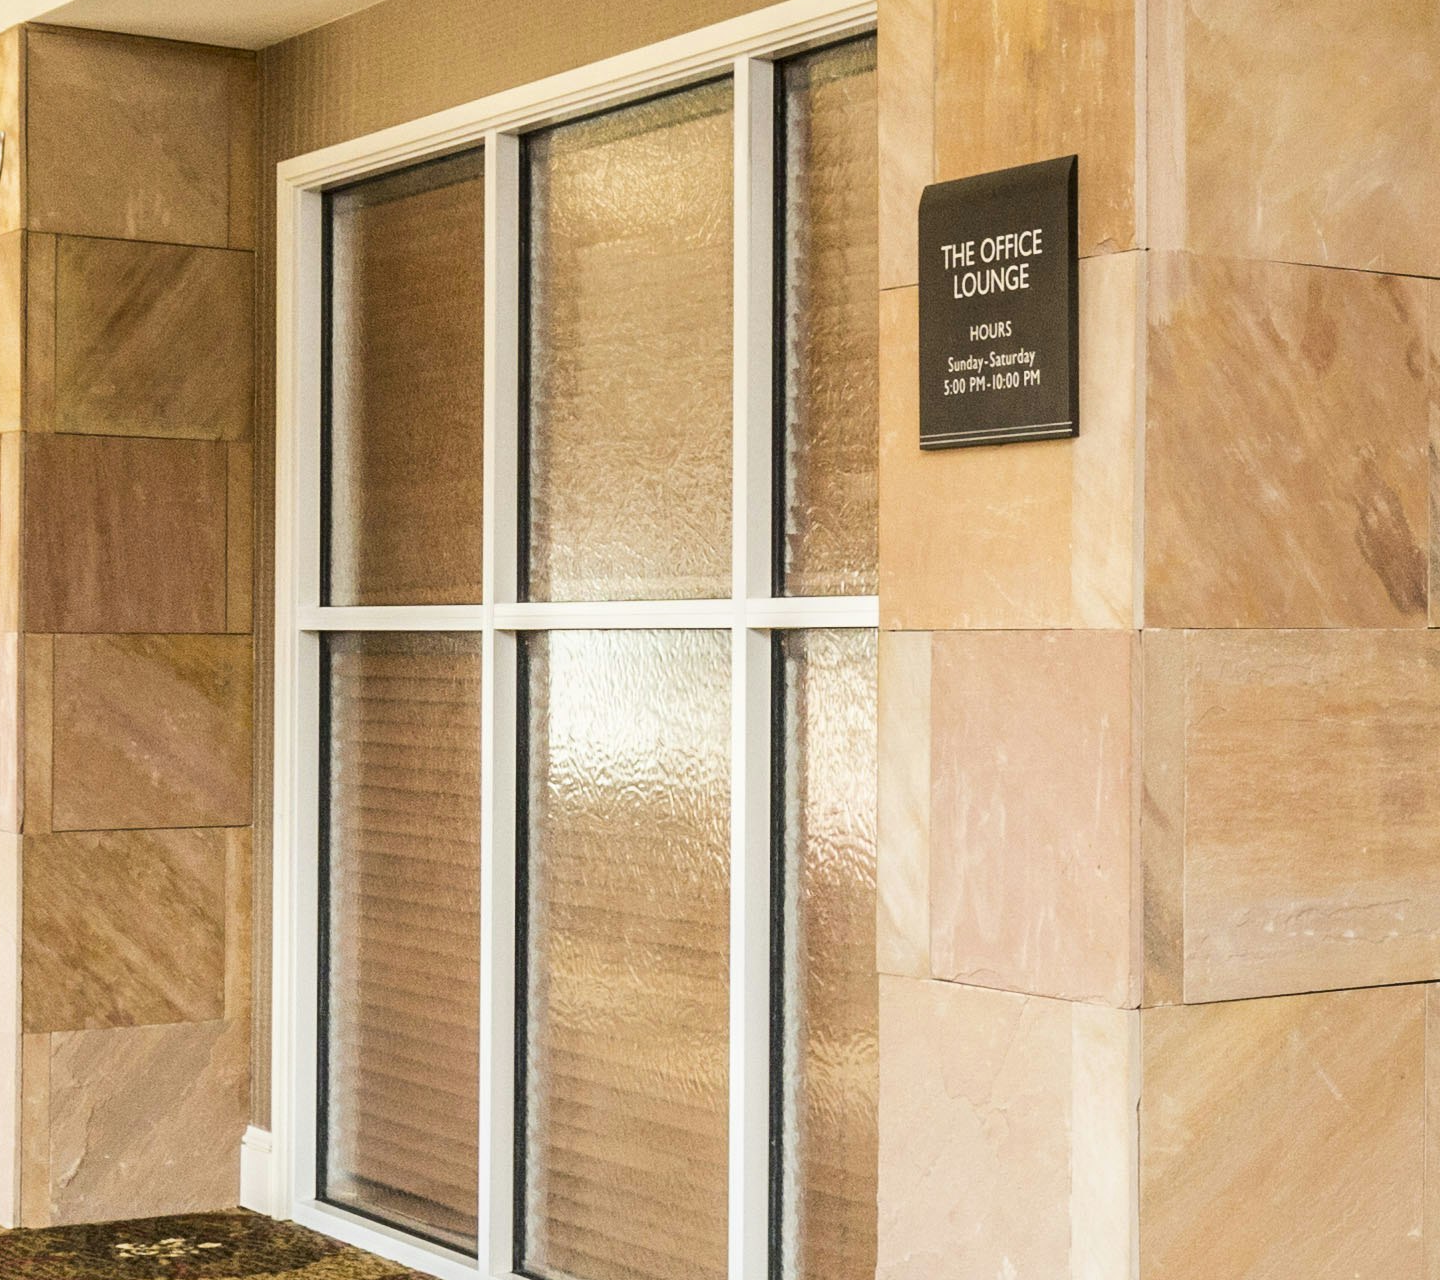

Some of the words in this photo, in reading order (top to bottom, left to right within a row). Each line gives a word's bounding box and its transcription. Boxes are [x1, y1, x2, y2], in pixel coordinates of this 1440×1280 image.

[941, 241, 975, 270] THE
[980, 228, 1043, 263] OFFICE
[954, 263, 1030, 299] LOUNGE
[969, 320, 1012, 341] HOURS
[947, 347, 1036, 374] Sunday-Saturday
[944, 378, 966, 396] 5:00
[1023, 369, 1040, 387] PM
